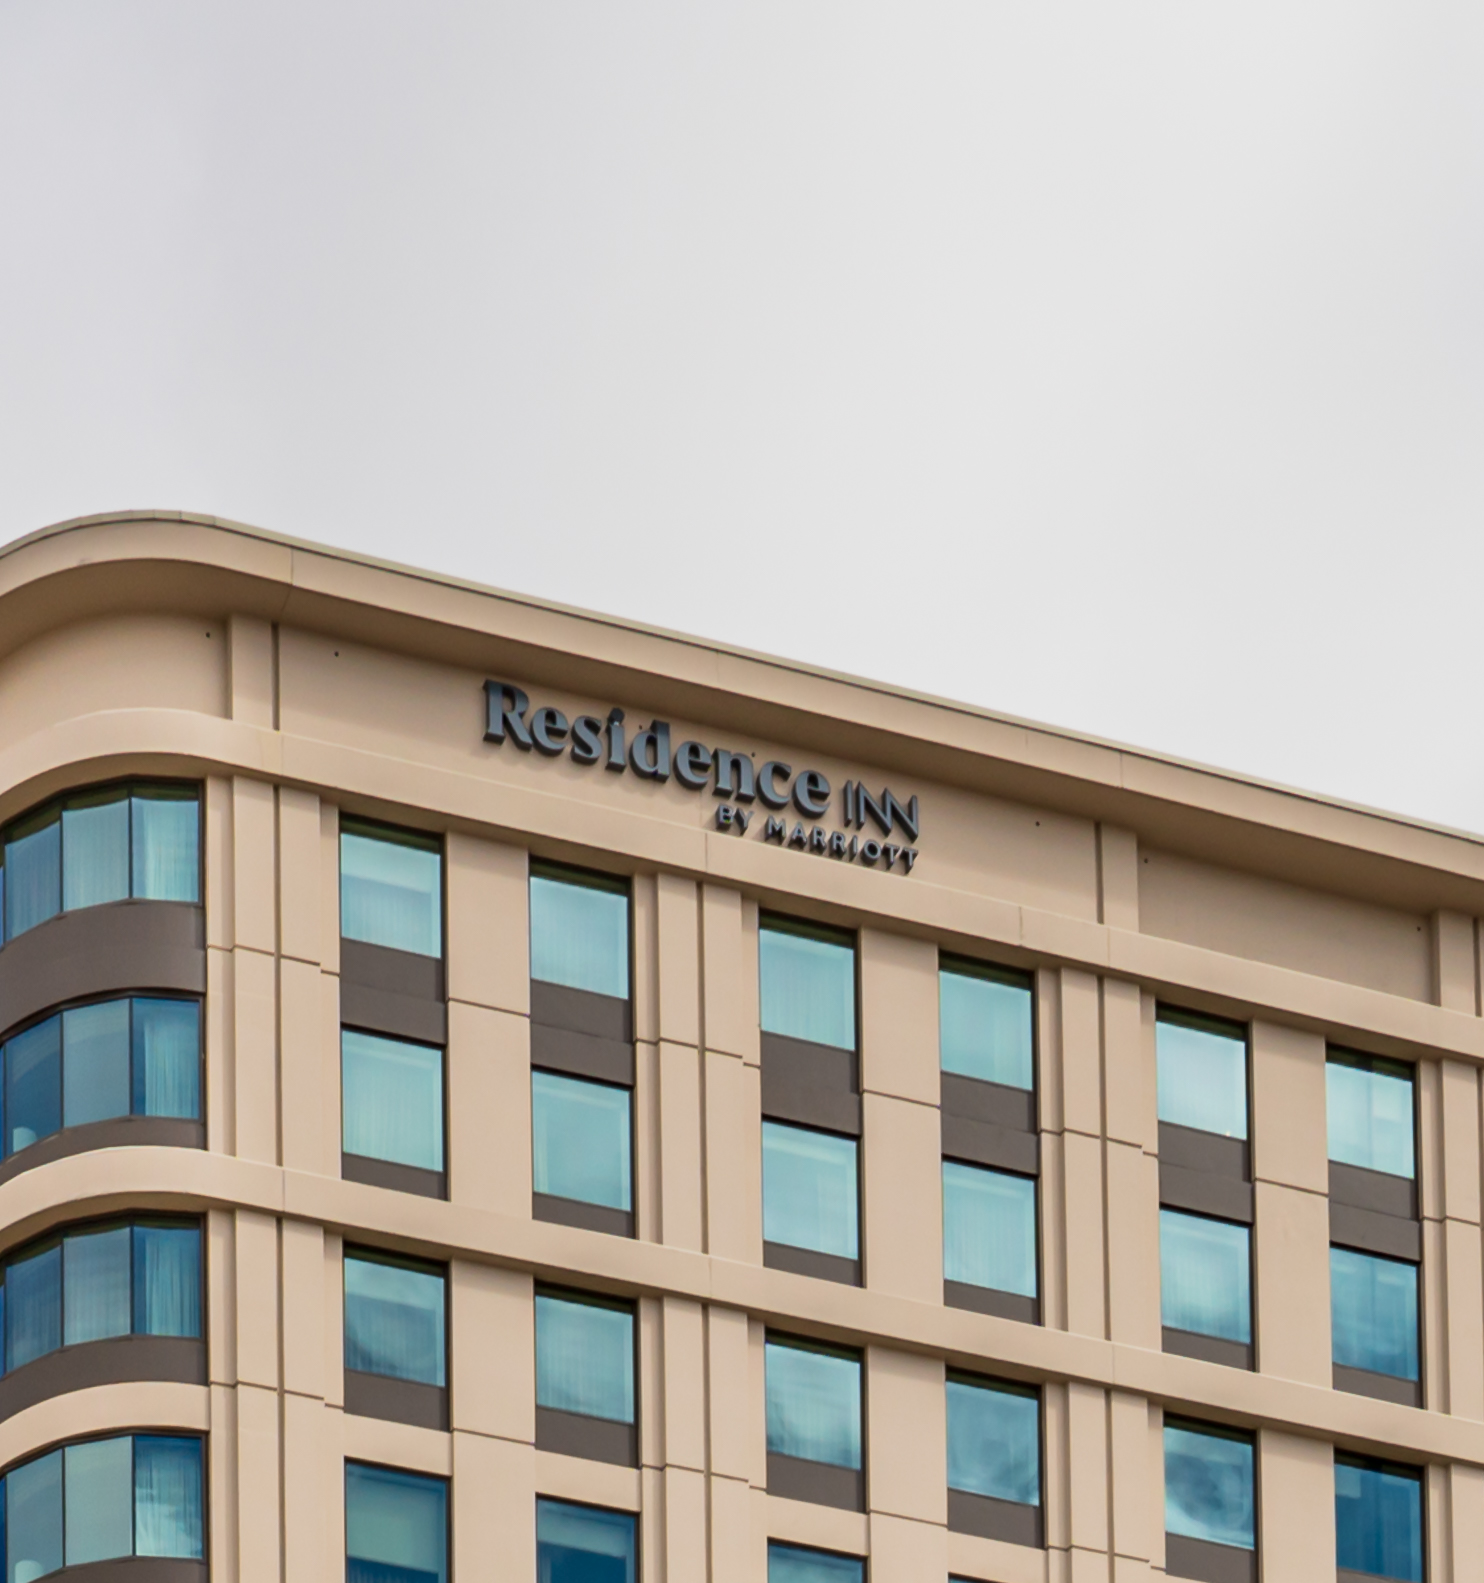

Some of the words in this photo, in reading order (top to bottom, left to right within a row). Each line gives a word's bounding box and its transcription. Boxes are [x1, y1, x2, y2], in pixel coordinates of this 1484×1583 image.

[483, 679, 830, 817] Residence
[843, 780, 919, 842] INN
[717, 804, 754, 834] BY
[765, 818, 918, 874] MARRIOTT
